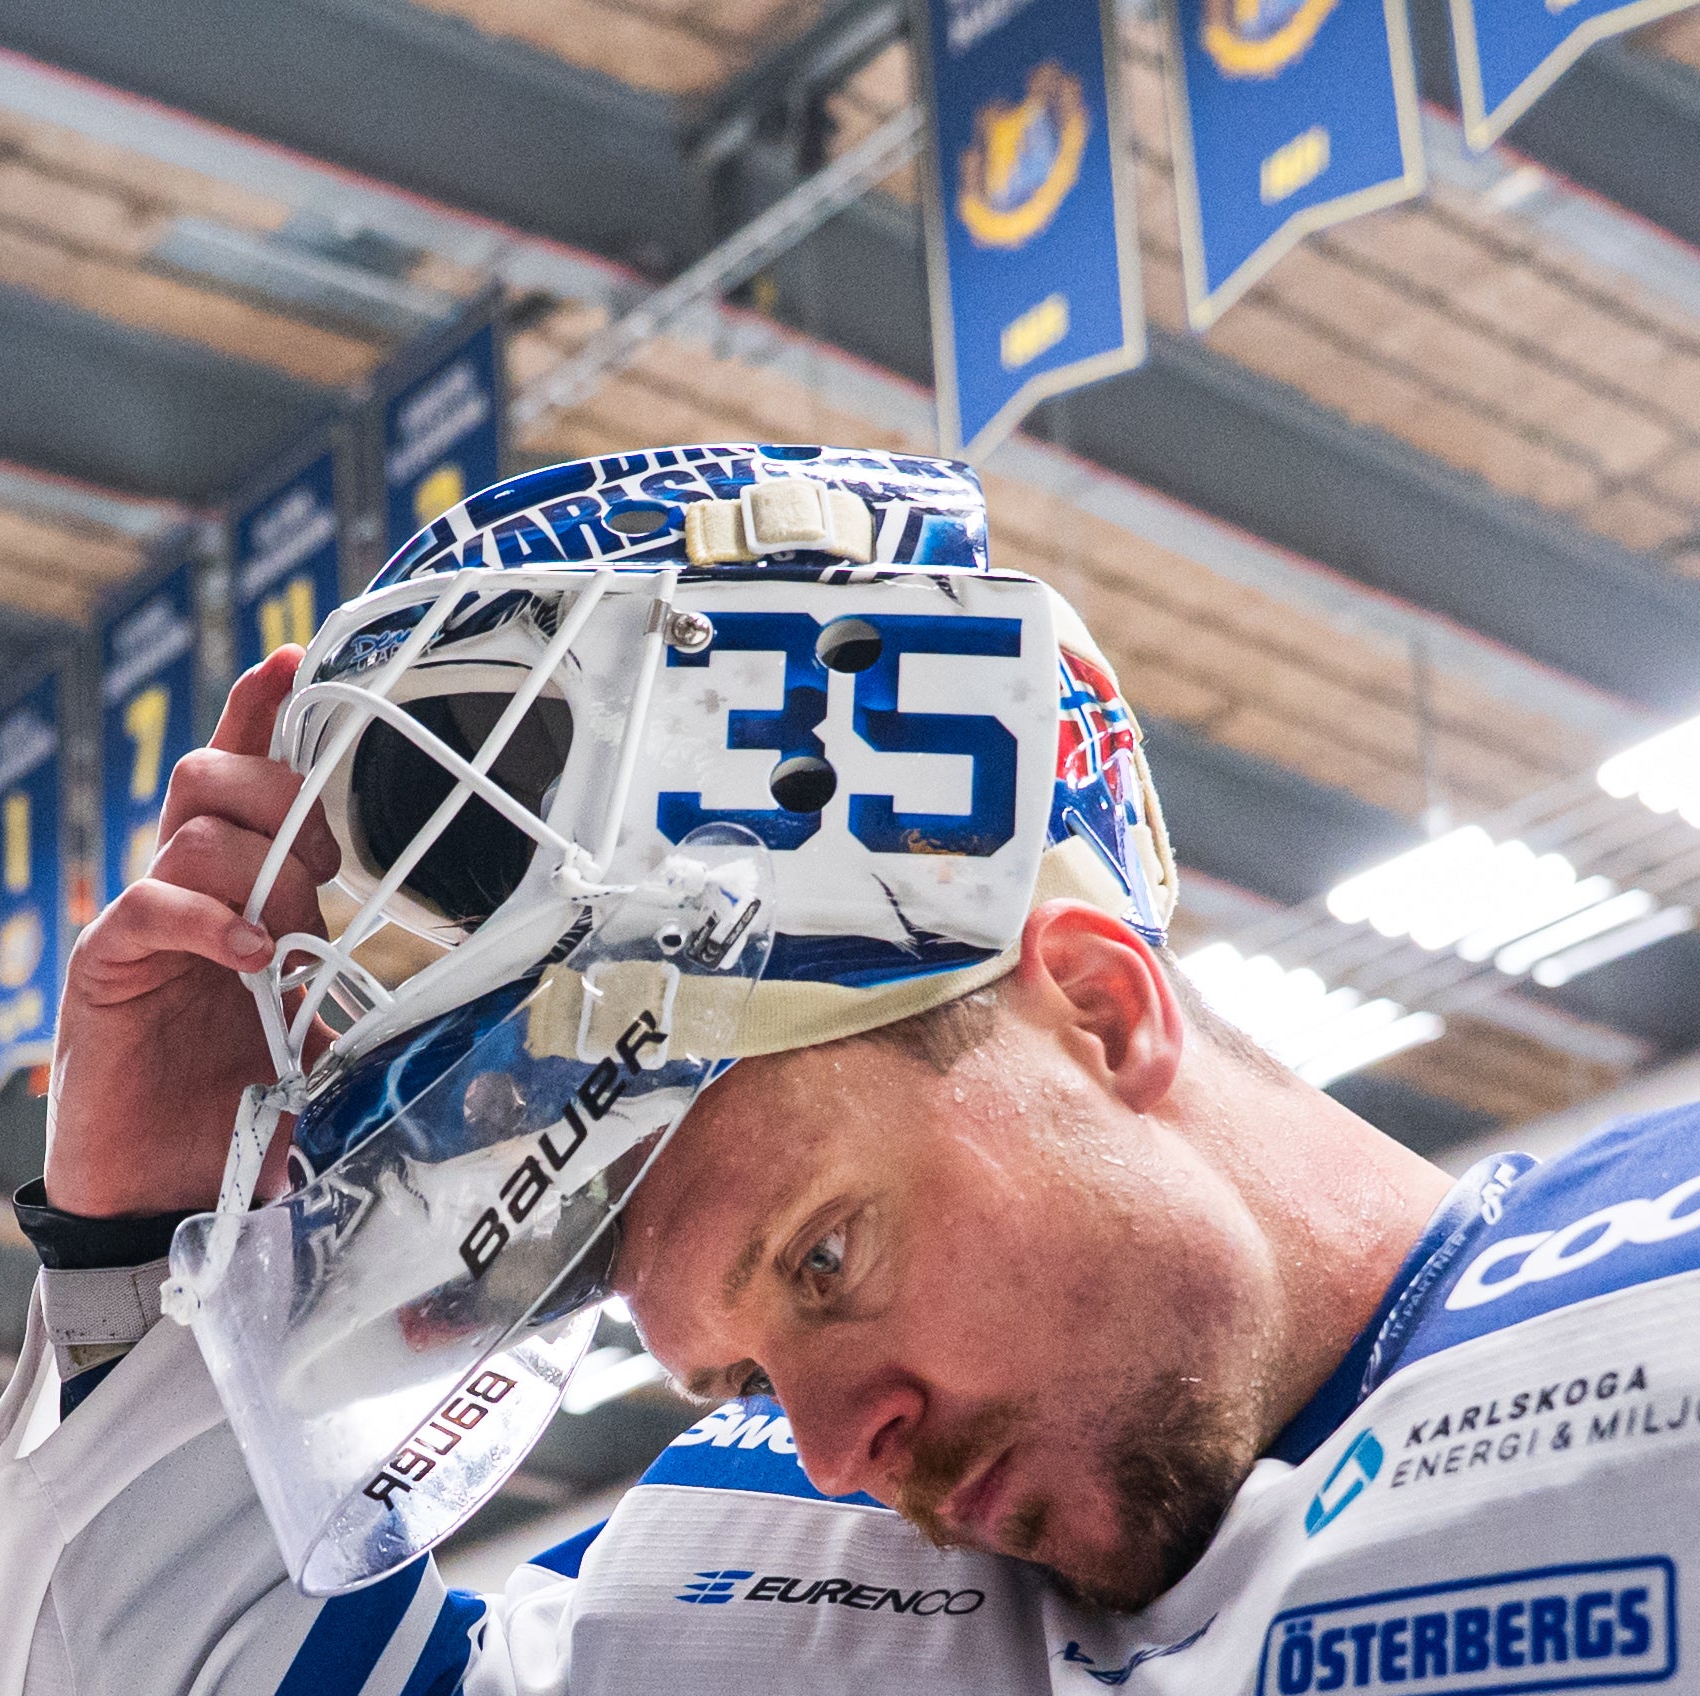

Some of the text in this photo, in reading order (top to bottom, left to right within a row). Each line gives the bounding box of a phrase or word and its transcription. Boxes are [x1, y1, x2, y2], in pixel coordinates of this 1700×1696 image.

[657, 610, 1022, 857] 35
[1403, 1363, 1648, 1449] KARLSKOGA
[1389, 1427, 1539, 1489] ENERGI
[1549, 1419, 1573, 1452] &
[744, 1575, 986, 1618] EURENCO
[1276, 1582, 1653, 1696] ÖSTERBERGS
